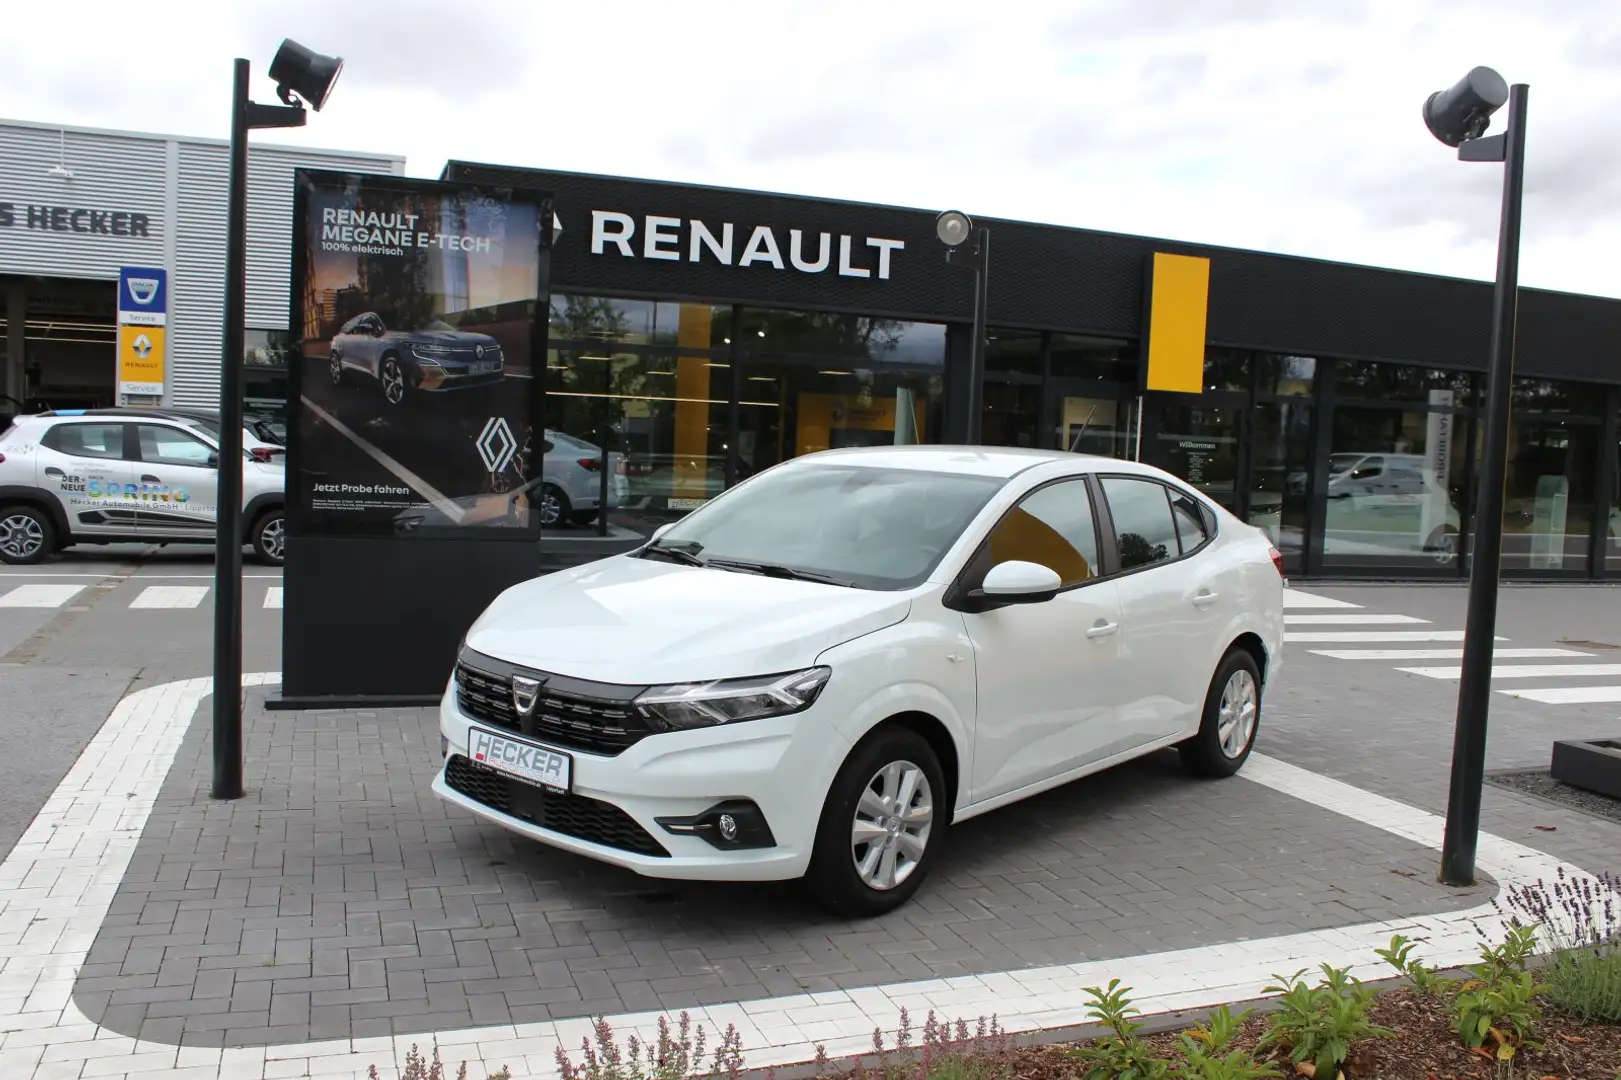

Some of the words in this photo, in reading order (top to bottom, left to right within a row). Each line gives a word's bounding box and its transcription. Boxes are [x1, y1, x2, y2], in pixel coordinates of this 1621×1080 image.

[27, 204, 150, 237] HECKER
[323, 207, 419, 230] RENAULT
[322, 225, 412, 247] MEGANE
[417, 231, 490, 253] E-TECH
[591, 209, 905, 280] RENAULT
[322, 241, 350, 252] 100%
[351, 242, 404, 256] elektrisch
[129, 314, 157, 323] Service
[125, 361, 159, 369] RENAULT
[1179, 441, 1216, 449] Willkommen
[62, 475, 80, 483] DER
[60, 483, 86, 492] NEUE
[88, 480, 191, 502] SPRING
[313, 483, 340, 492] Jetzt
[341, 484, 373, 493] Probe
[374, 484, 410, 495] fahren
[70, 498, 100, 506] Hecker
[102, 500, 151, 509] Automobile
[152, 502, 178, 510] GmbH
[185, 503, 219, 512] Lippsta
[476, 734, 563, 777] HECKER
